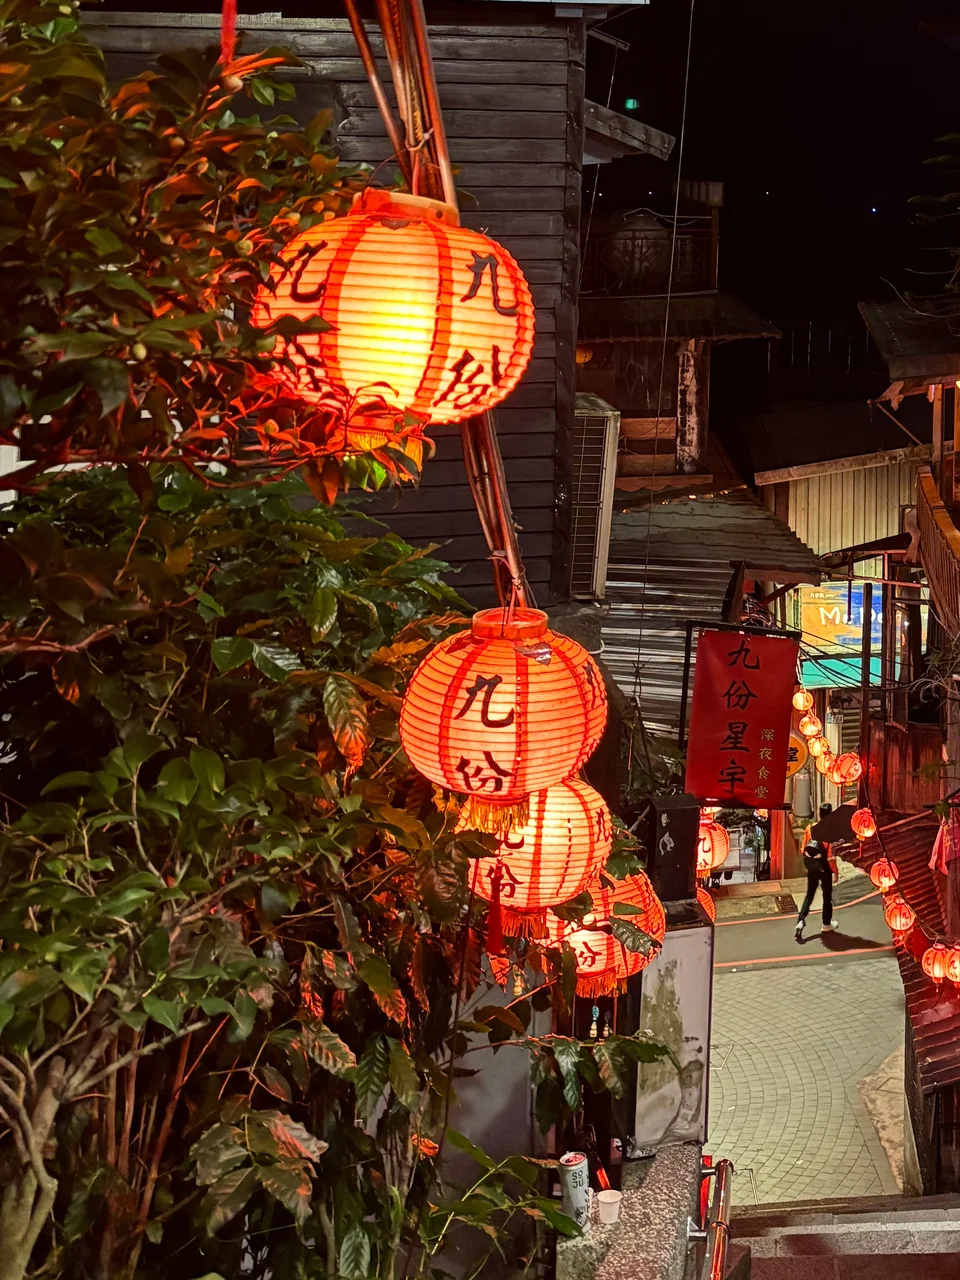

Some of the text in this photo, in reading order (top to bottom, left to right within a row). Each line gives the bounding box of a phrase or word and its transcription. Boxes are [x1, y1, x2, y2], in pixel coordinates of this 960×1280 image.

[433, 250, 519, 410] 九份
[453, 673, 516, 793] 九份
[717, 639, 761, 795] 九份星宇
[753, 728, 776, 800] 深夜食堂
